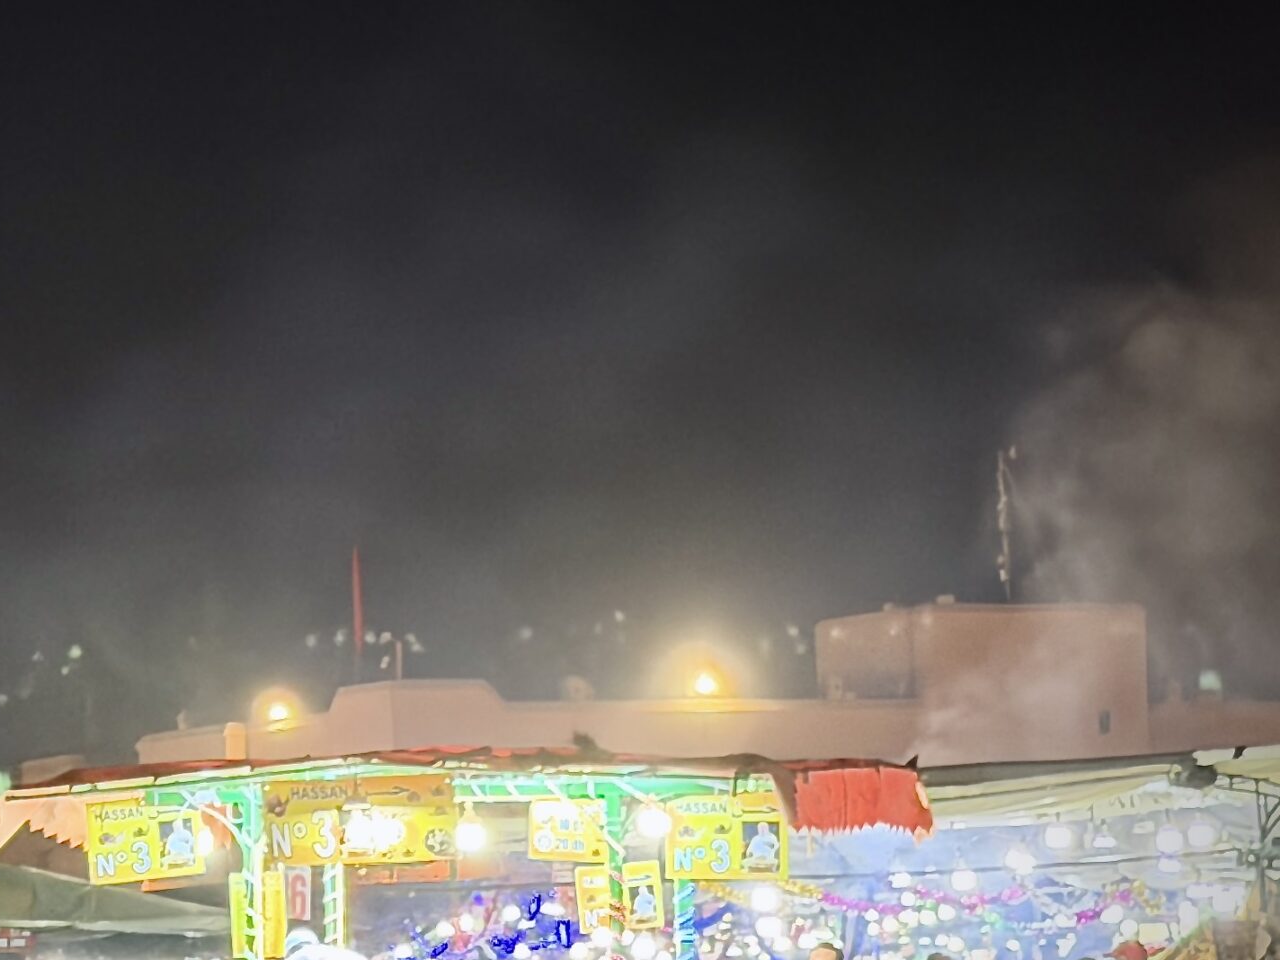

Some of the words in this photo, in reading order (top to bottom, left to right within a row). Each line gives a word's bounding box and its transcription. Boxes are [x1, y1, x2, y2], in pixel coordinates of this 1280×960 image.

[290, 785, 348, 801] HASSAN
[94, 806, 144, 822] HASSAN
[311, 809, 338, 860] 3
[131, 840, 152, 875] 3
[709, 838, 731, 874] 3
[290, 872, 307, 920] 6
